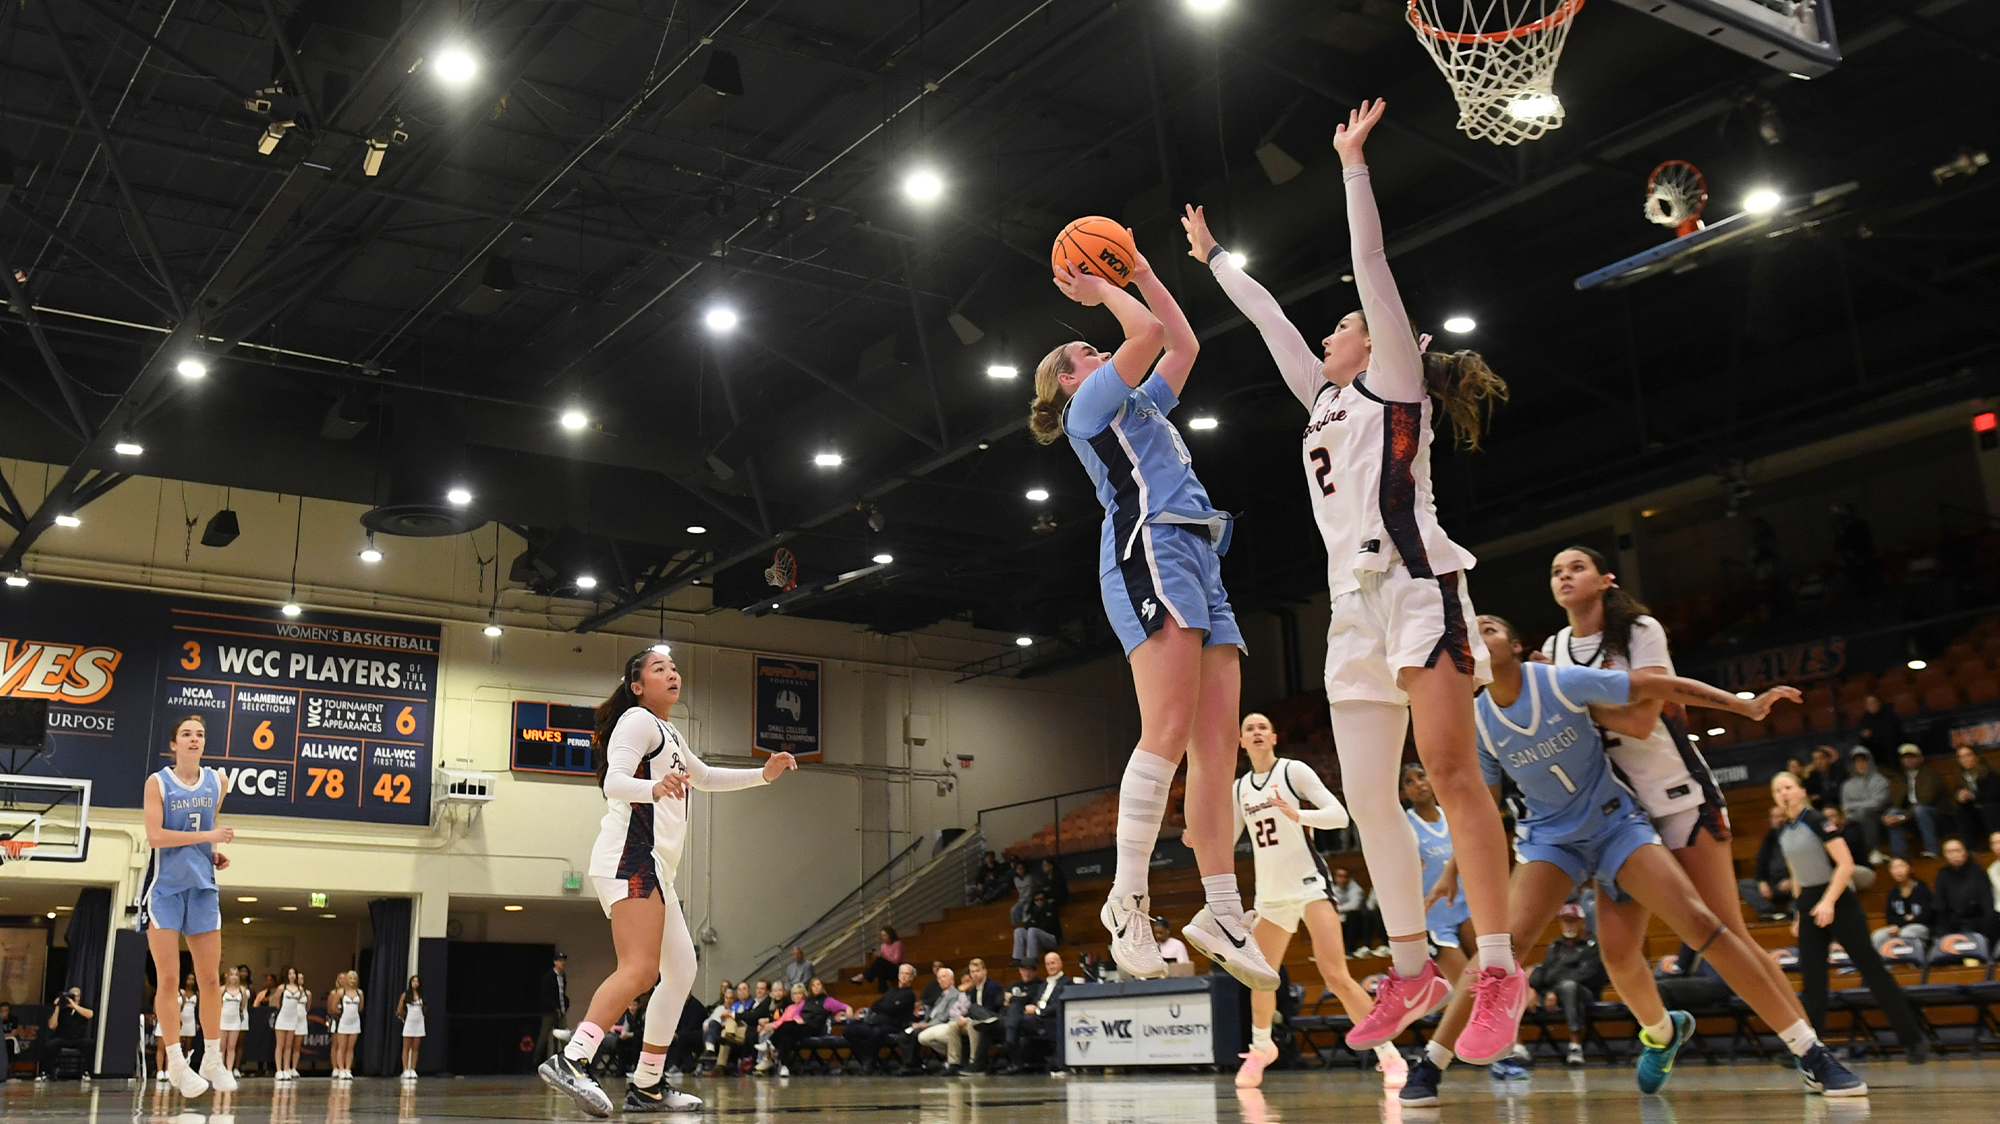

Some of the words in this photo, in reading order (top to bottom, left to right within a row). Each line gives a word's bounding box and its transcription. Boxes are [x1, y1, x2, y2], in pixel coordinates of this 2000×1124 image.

[1099, 248, 1130, 279] NCAA
[1309, 447, 1336, 498] 2
[276, 624, 339, 641] WOMEN'S
[343, 631, 433, 651] BASKETBALL
[181, 641, 201, 671] 3
[218, 646, 280, 677] WCC
[289, 653, 401, 688] PLAYERS
[409, 664, 421, 672] OF
[402, 681, 427, 691] YEAR
[406, 672, 423, 682] THE
[182, 687, 213, 699] NCAA
[237, 692, 296, 705] ALL-AMERICAN
[167, 697, 226, 709] APPEARANCES
[241, 703, 290, 714] SELECTIONS
[324, 699, 384, 713] TOURNAMENT
[48, 712, 115, 731] URPOSE
[307, 698, 322, 728] WCC
[325, 710, 382, 722] FINAL
[395, 706, 416, 735] 6
[252, 720, 275, 750] 6
[322, 720, 382, 733] APPEARANCES
[523, 729, 562, 743] WAVES
[567, 738, 591, 747] PERIOD
[301, 743, 358, 761] ALL-WCC
[374, 747, 416, 760] ALL-WCC
[1508, 747, 1540, 769] SAN
[1536, 726, 1579, 759] DIEGO
[373, 757, 393, 766] FIRST
[396, 758, 416, 768] TEAM
[277, 770, 288, 797] TITLES
[306, 767, 345, 799] 78
[1548, 763, 1578, 795] 1
[373, 773, 411, 804] 42
[171, 799, 190, 811] SAN
[188, 812, 201, 832] 3
[1255, 817, 1279, 848] 22
[1101, 1020, 1133, 1038] WCC
[1143, 1023, 1210, 1037] UNIVERSITY
